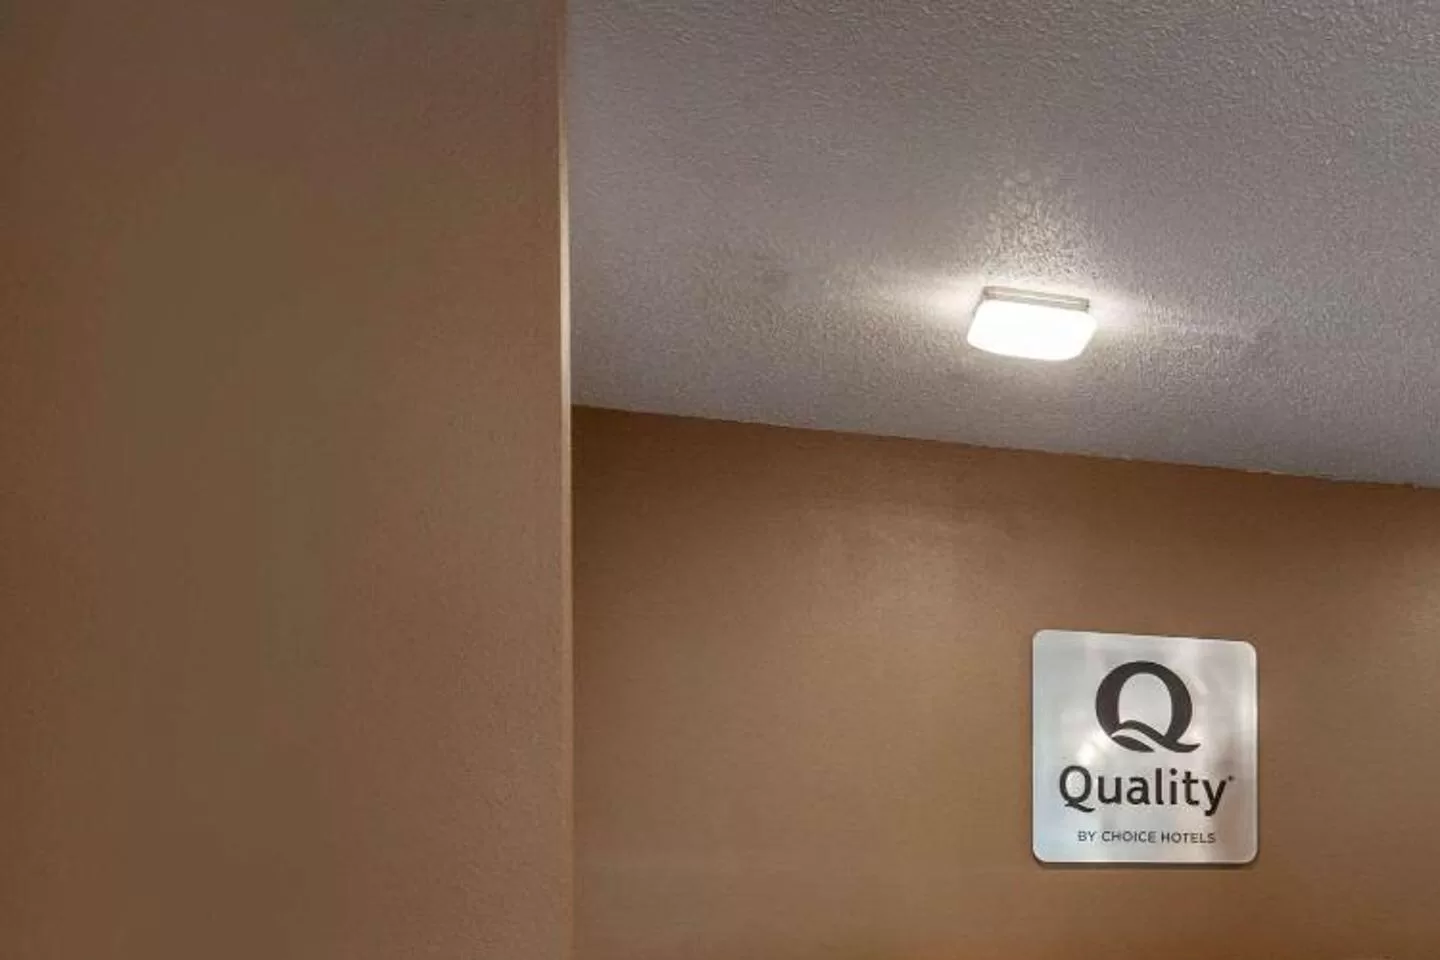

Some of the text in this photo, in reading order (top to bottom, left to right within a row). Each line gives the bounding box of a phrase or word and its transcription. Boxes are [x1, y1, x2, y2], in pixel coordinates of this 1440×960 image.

[1059, 765, 1227, 817] Quality
[1078, 830, 1216, 844] BY CHOICE HOTELS
